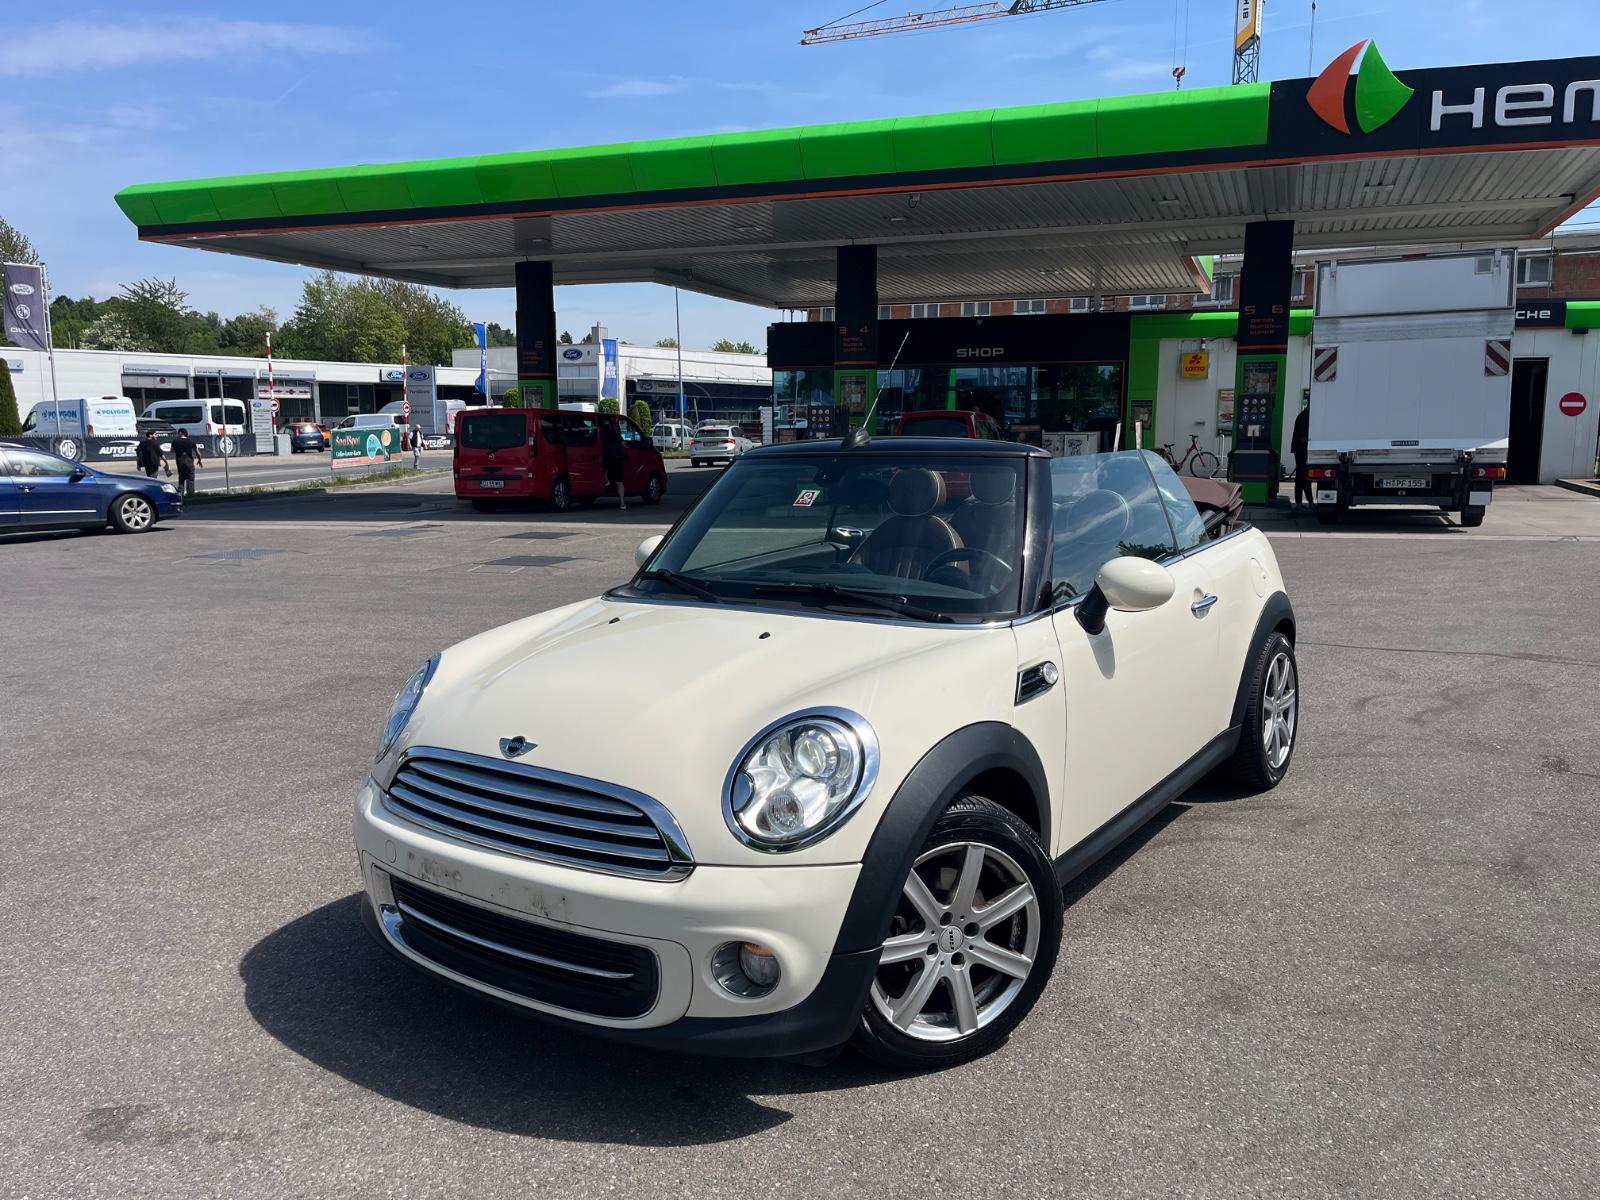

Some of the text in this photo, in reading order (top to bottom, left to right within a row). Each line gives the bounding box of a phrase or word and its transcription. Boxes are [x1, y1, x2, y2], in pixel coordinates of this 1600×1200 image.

[1271, 304, 1284, 315] 6
[956, 347, 1005, 358] SHOP
[47, 409, 77, 419] POYGON
[102, 408, 129, 416] POLYGON
[98, 446, 125, 455] AUTO
